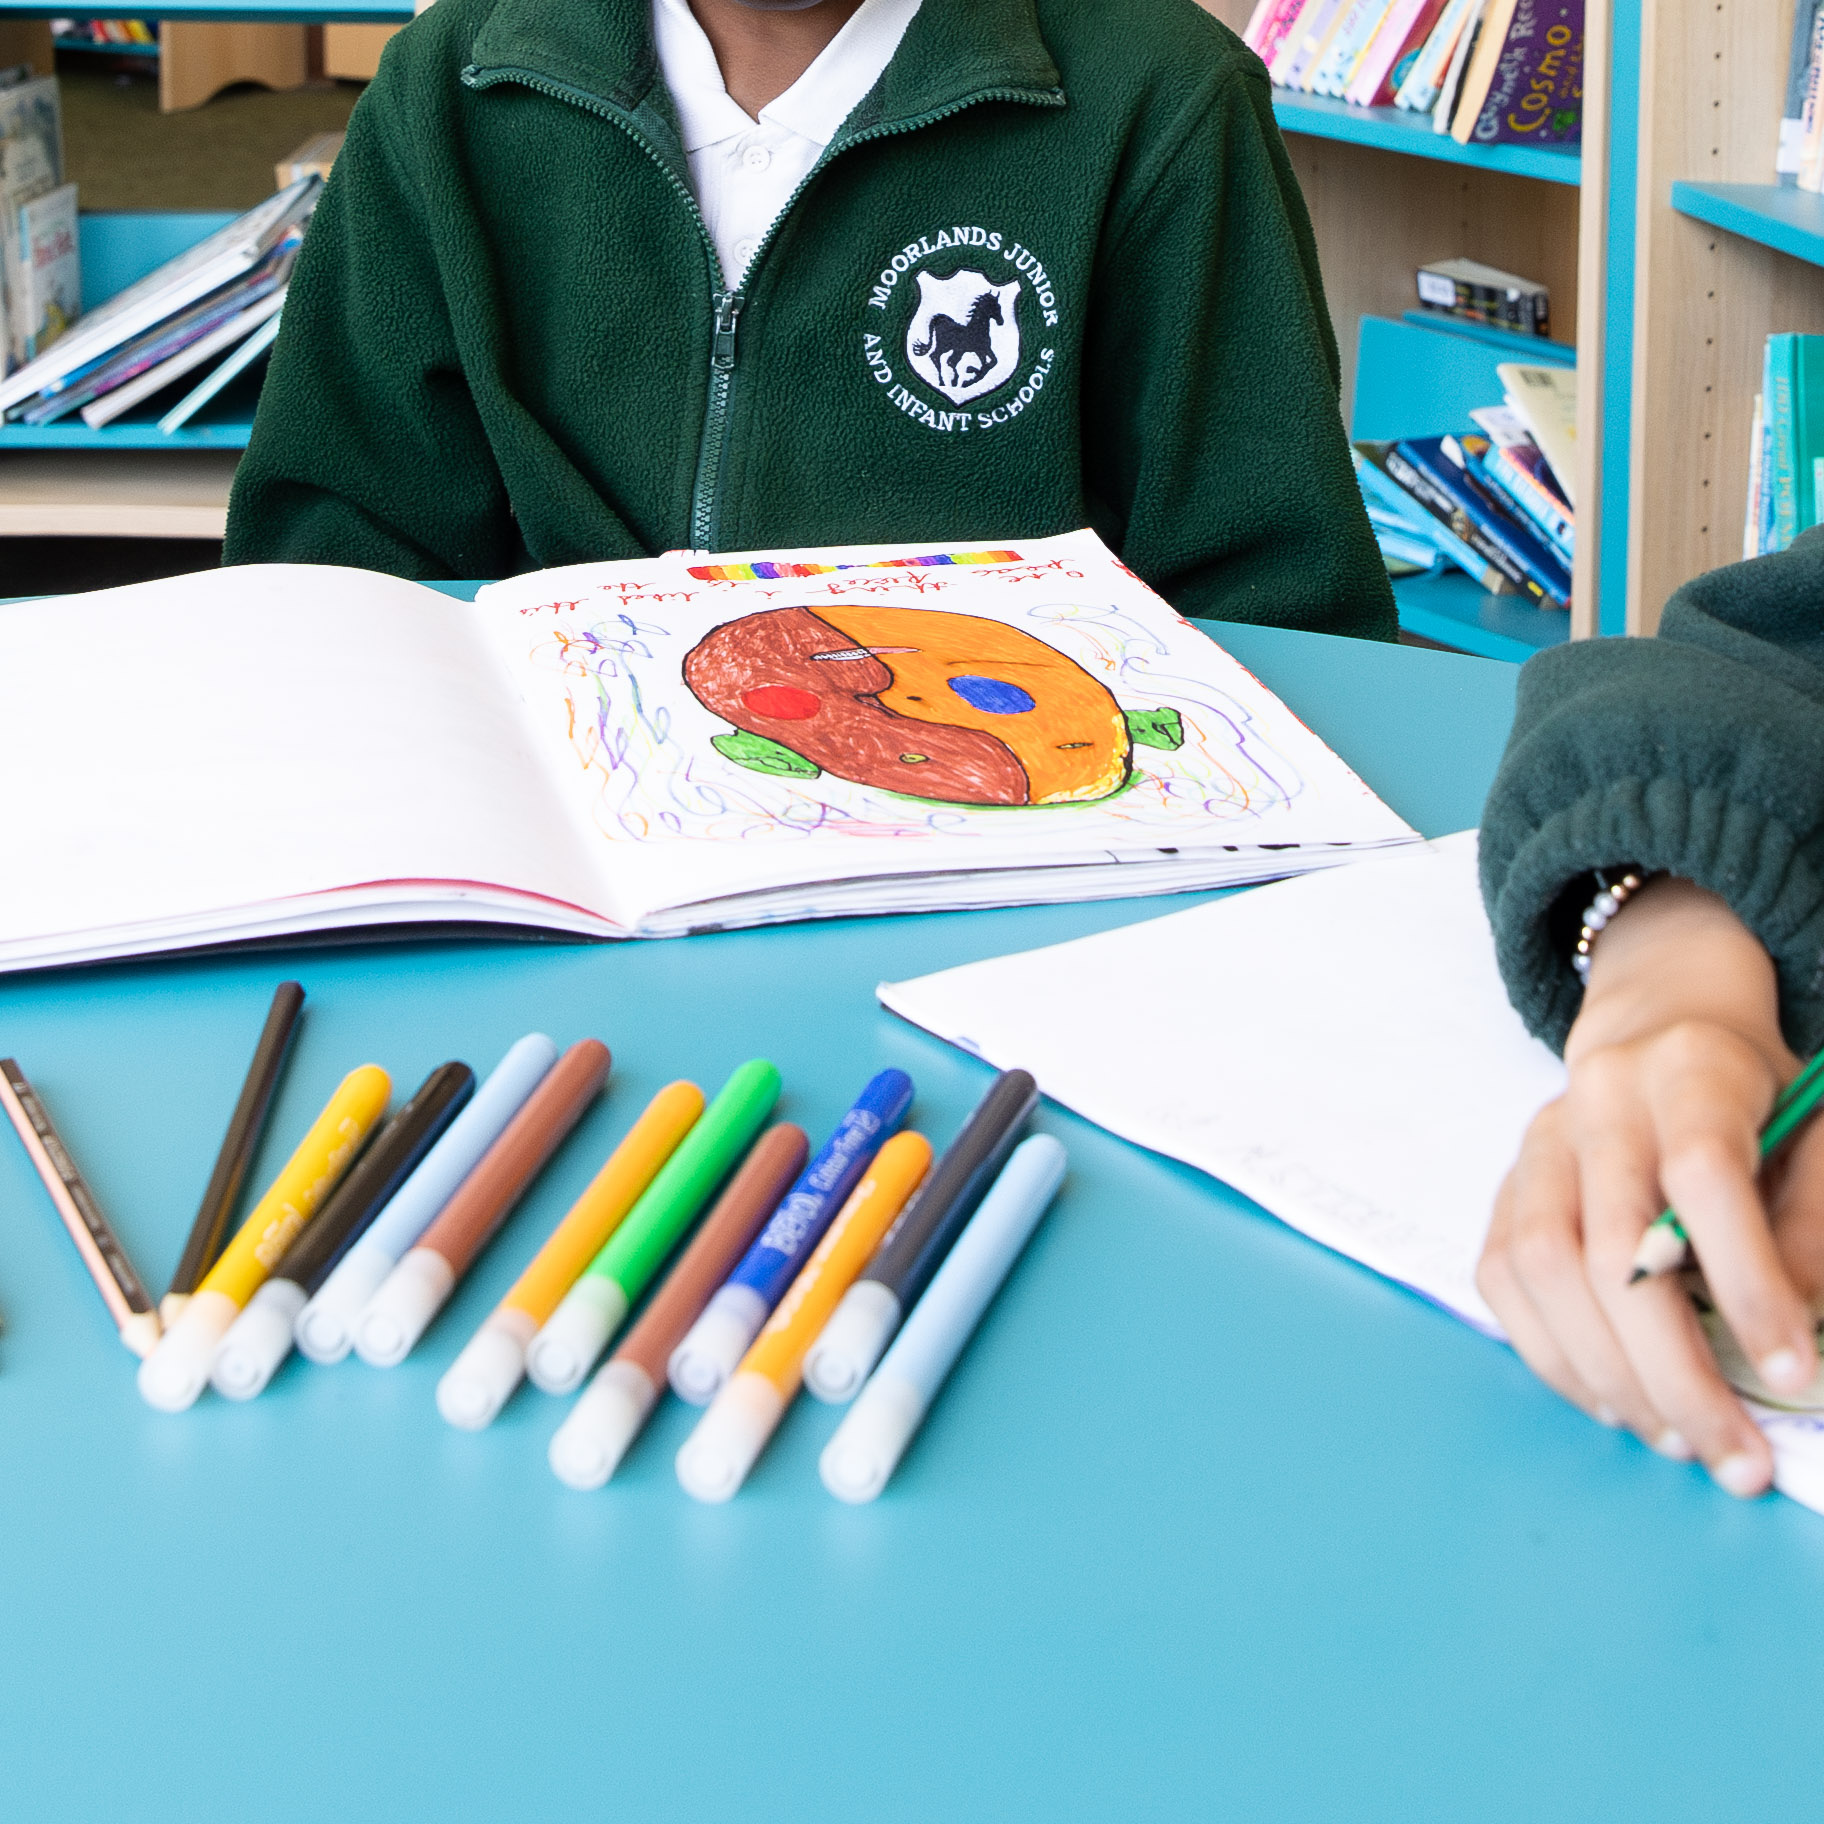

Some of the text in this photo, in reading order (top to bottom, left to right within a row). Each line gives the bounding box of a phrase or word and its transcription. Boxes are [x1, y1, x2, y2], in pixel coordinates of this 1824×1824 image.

[1507, 25, 1572, 133] Cosmo
[868, 226, 1058, 327] MOORLANDS JUNIOR
[863, 333, 1055, 432] AND INFANT SCHOOLS
